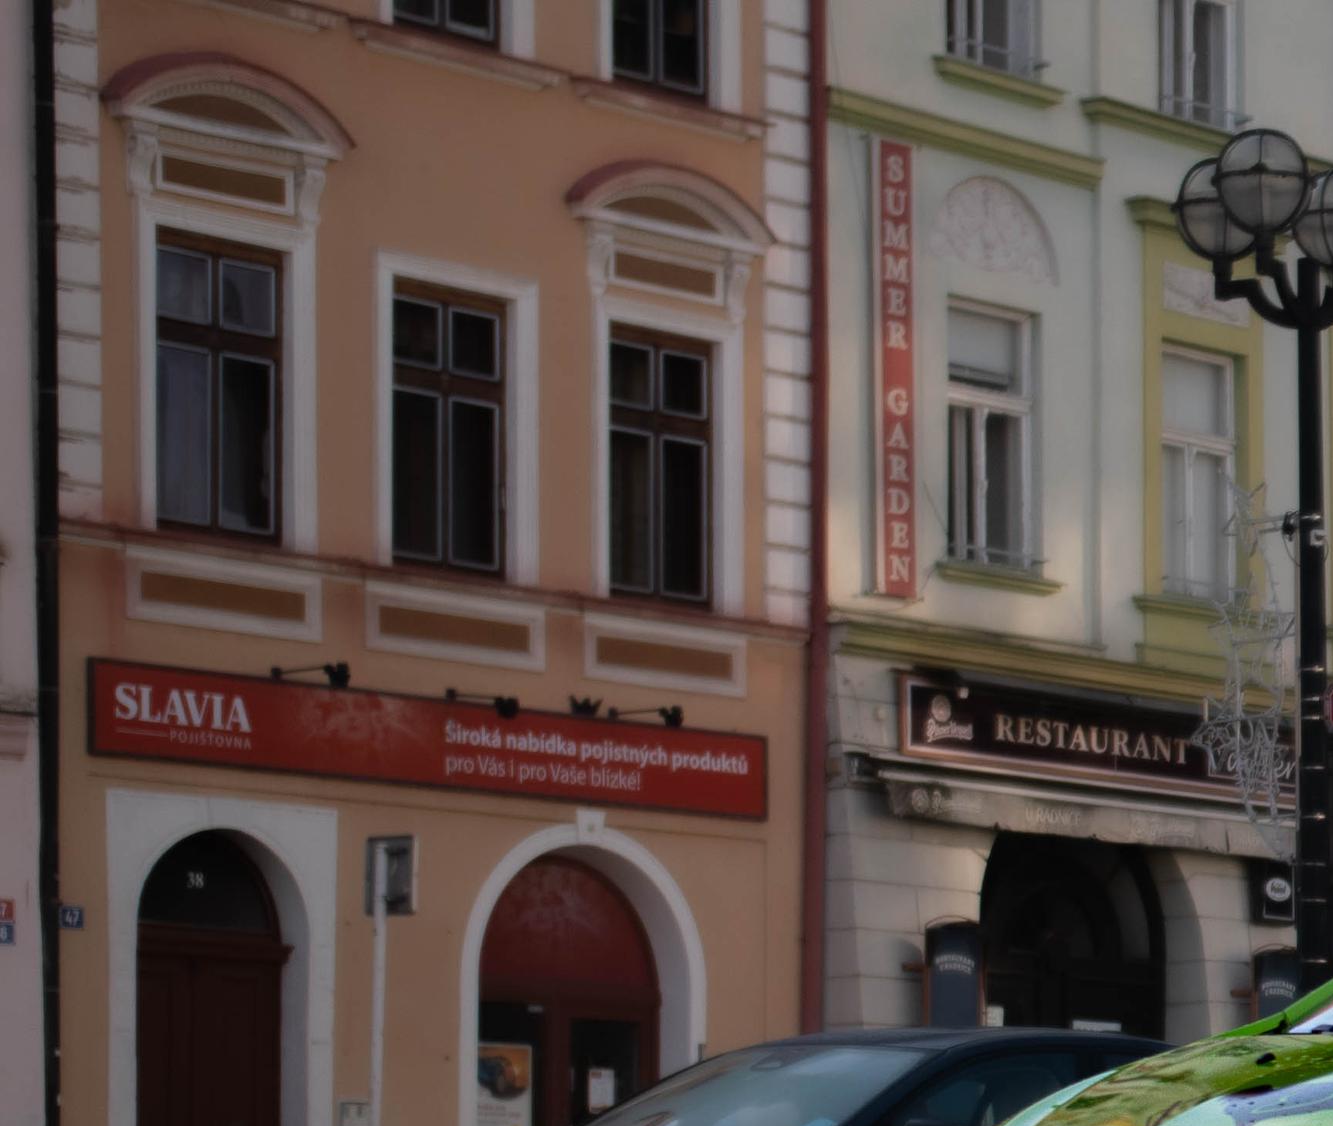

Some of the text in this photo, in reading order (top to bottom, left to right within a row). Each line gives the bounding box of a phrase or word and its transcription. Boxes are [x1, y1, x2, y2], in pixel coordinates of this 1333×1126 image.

[884, 155, 909, 349] SUMMER
[887, 388, 910, 583] GARDEN
[115, 682, 252, 734] SLAVIA
[446, 719, 748, 775] Široká nabídka pojistných produktů
[995, 714, 1188, 765] RESTAURANT
[446, 756, 475, 776] pro
[477, 754, 506, 777] Vás
[518, 763, 547, 785] pro
[550, 762, 587, 785] Vaše
[186, 871, 205, 889] 38
[65, 909, 81, 928] 47
